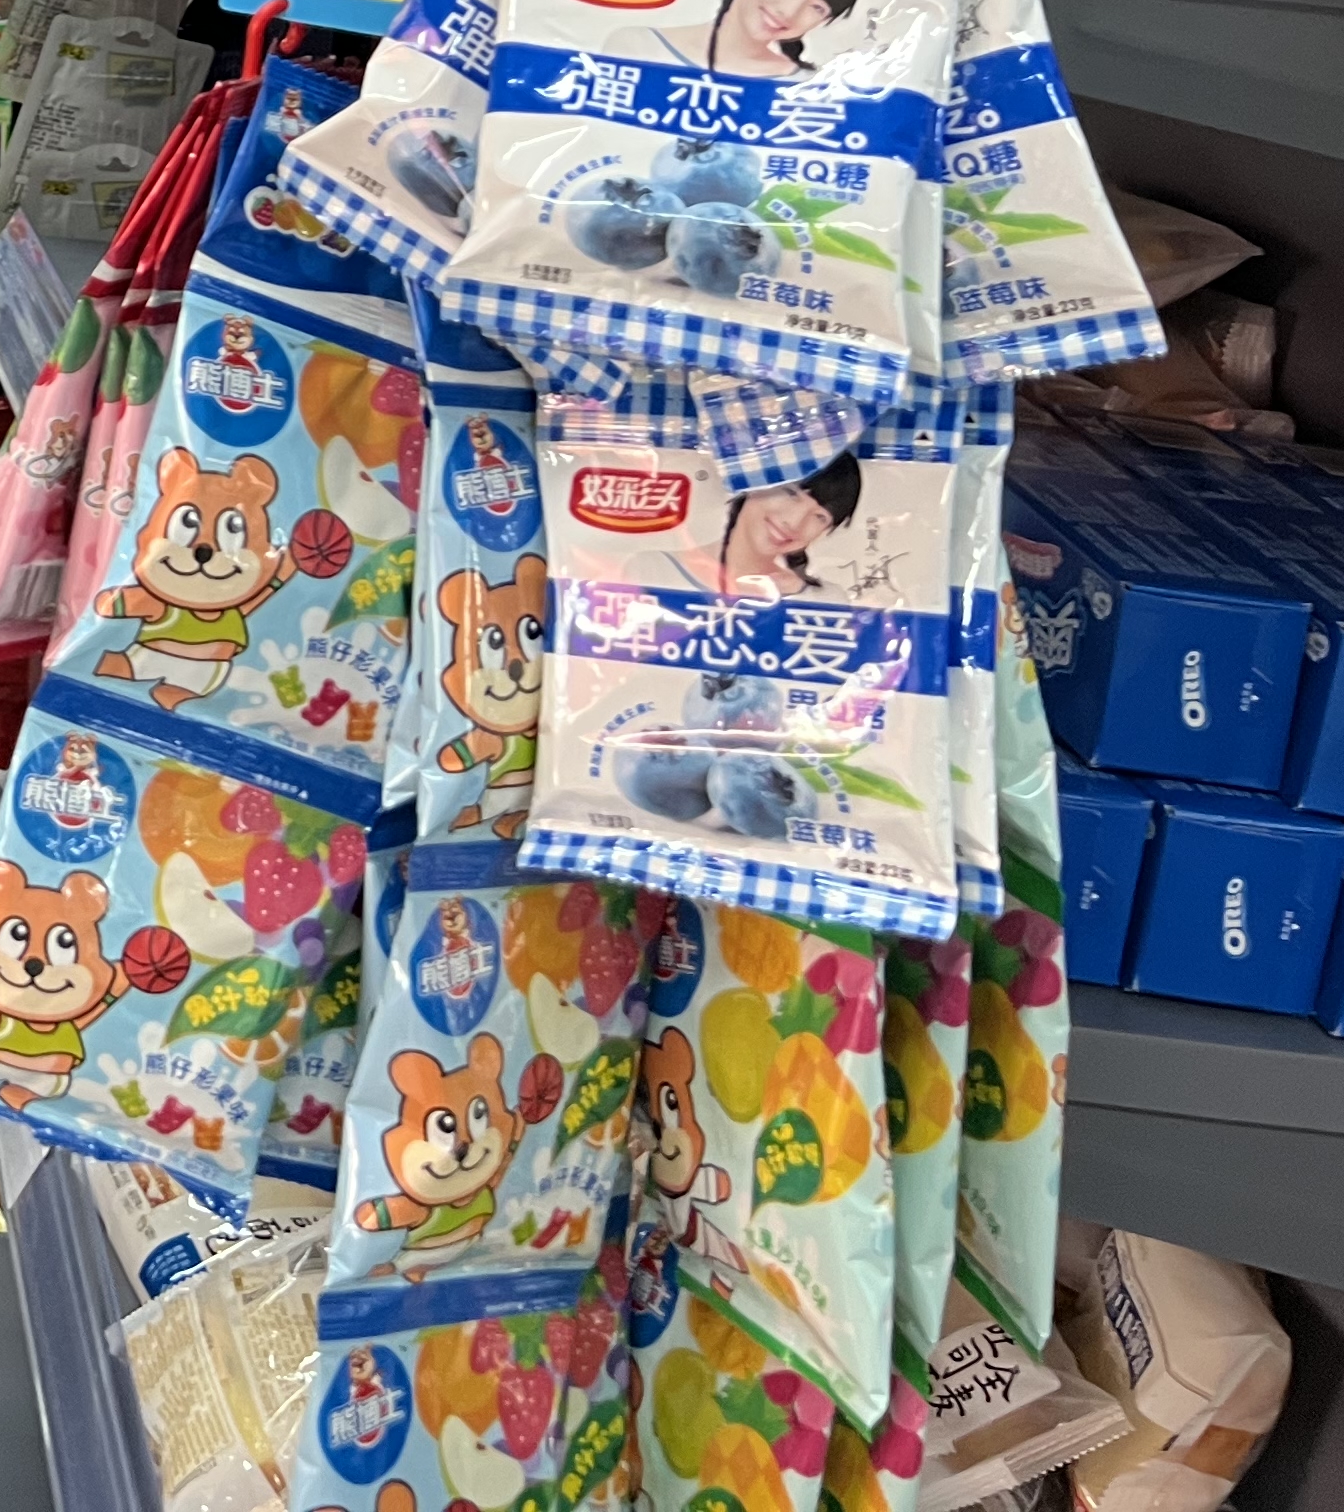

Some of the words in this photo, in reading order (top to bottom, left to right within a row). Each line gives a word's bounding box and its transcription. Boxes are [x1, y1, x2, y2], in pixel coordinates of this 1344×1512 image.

[761, 154, 871, 193] 果Q糖
[739, 274, 834, 314] 蓝莓味
[955, 276, 1051, 314] 蓝莓味
[185, 357, 287, 410] 熊博士
[452, 461, 537, 510] 熊博士
[579, 473, 684, 512] 好彩头
[1181, 649, 1207, 730] OREO
[20, 776, 128, 824] 熊博士
[1222, 876, 1248, 958] OREO
[418, 940, 495, 996] 熊博士
